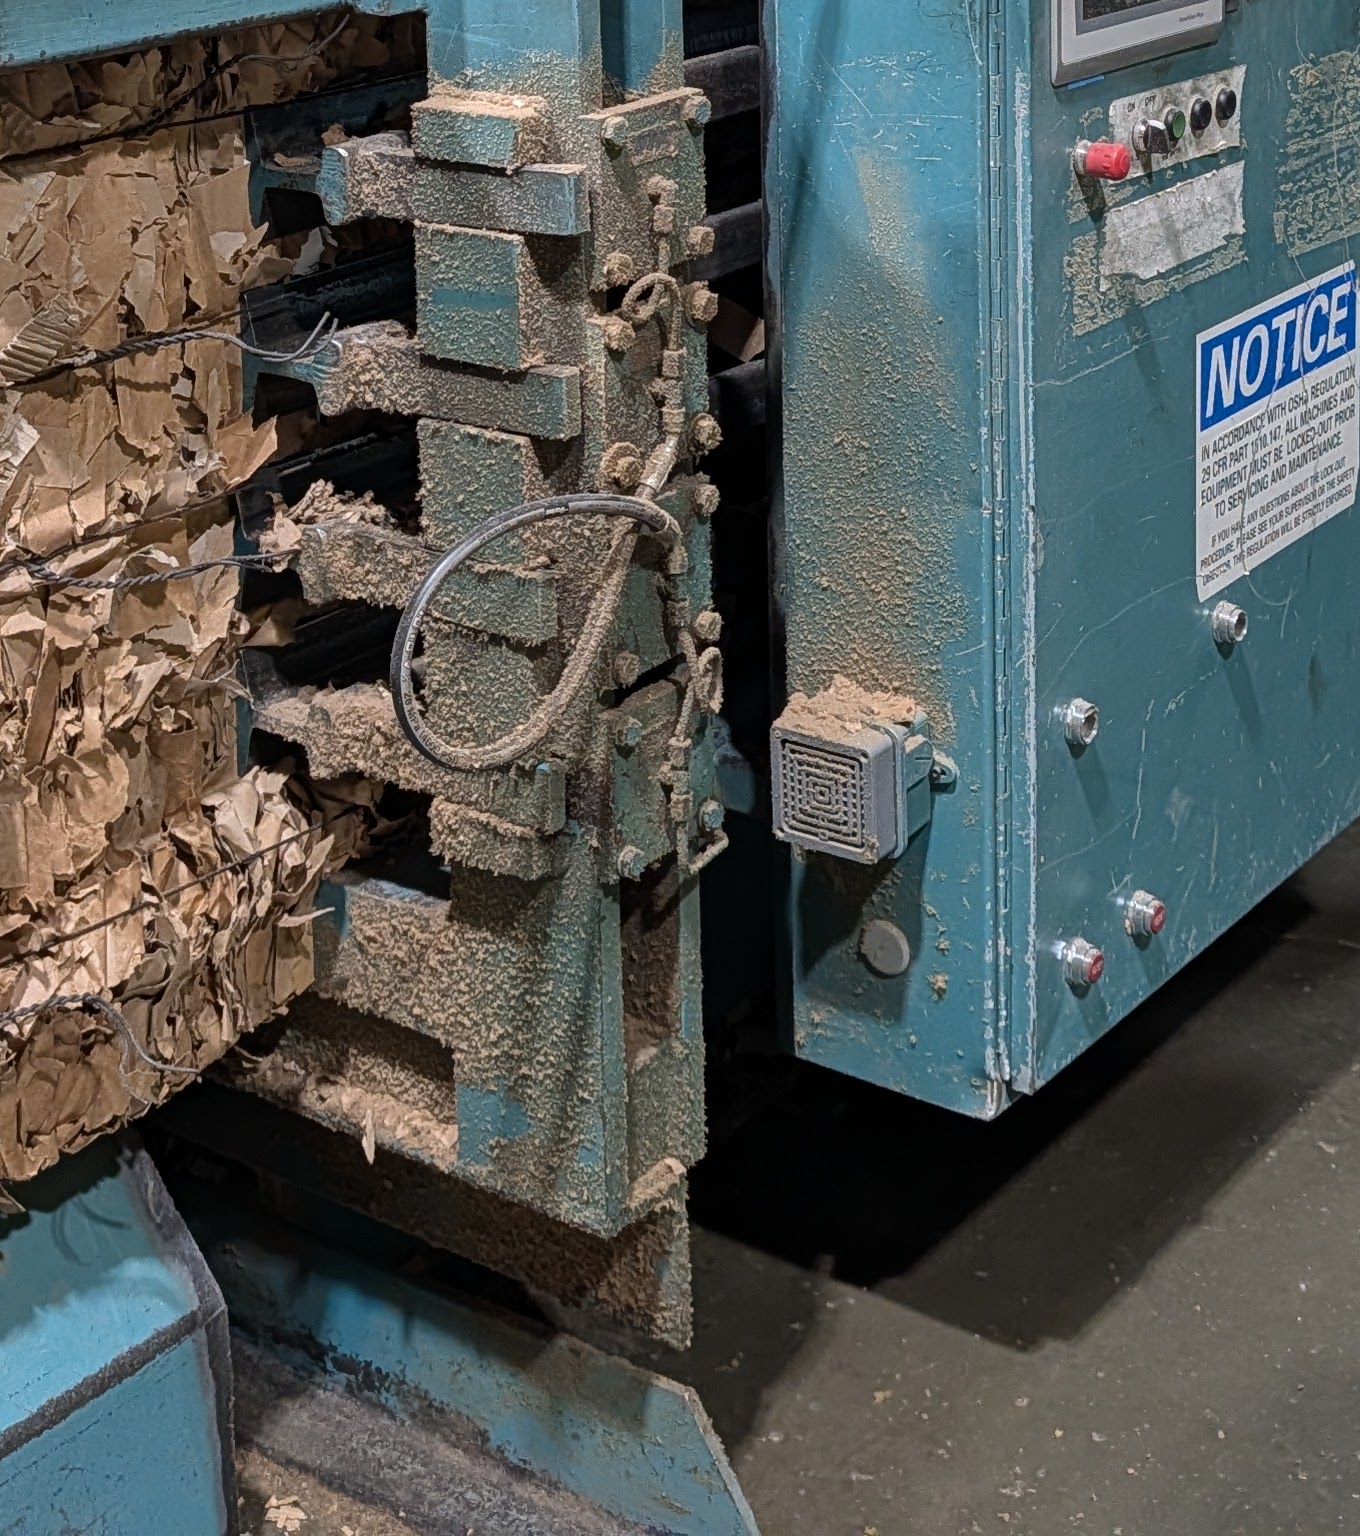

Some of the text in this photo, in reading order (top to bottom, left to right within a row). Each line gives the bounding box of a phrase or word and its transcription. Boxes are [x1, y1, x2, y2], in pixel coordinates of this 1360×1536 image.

[1206, 281, 1351, 418] NOTICE
[1200, 403, 1356, 507] EQUIPMENT MUST BE LOCKED-OUT PRIOR
[1201, 364, 1356, 462] IN ACCORDANCE WITH OSHA REGULATION
[1201, 465, 1211, 484] 29
[1212, 456, 1228, 478] CFR
[1229, 443, 1249, 469] PART
[1285, 415, 1298, 436] ALL
[1300, 397, 1338, 427] MACHINES
[1340, 384, 1355, 405] AND
[1211, 456, 1346, 548] IF YOU HAVE ANY QUESTIONS ABOUT THE LOCK-OUT
[1215, 431, 1343, 519] TO SERVICING AND MAINTENANCE.
[1235, 527, 1257, 549] PLEASE
[1257, 520, 1268, 537] SEE
[1268, 510, 1284, 530] YOUR
[1284, 488, 1317, 519] SUPERVISOR
[1317, 482, 1326, 498] OR
[1326, 476, 1336, 493] THE
[1336, 466, 1355, 488] SAFETY
[1246, 531, 1280, 558] REGULATION
[1280, 521, 1293, 537] WILL
[1293, 517, 1301, 529] BE
[1301, 501, 1324, 524] STRICTLY
